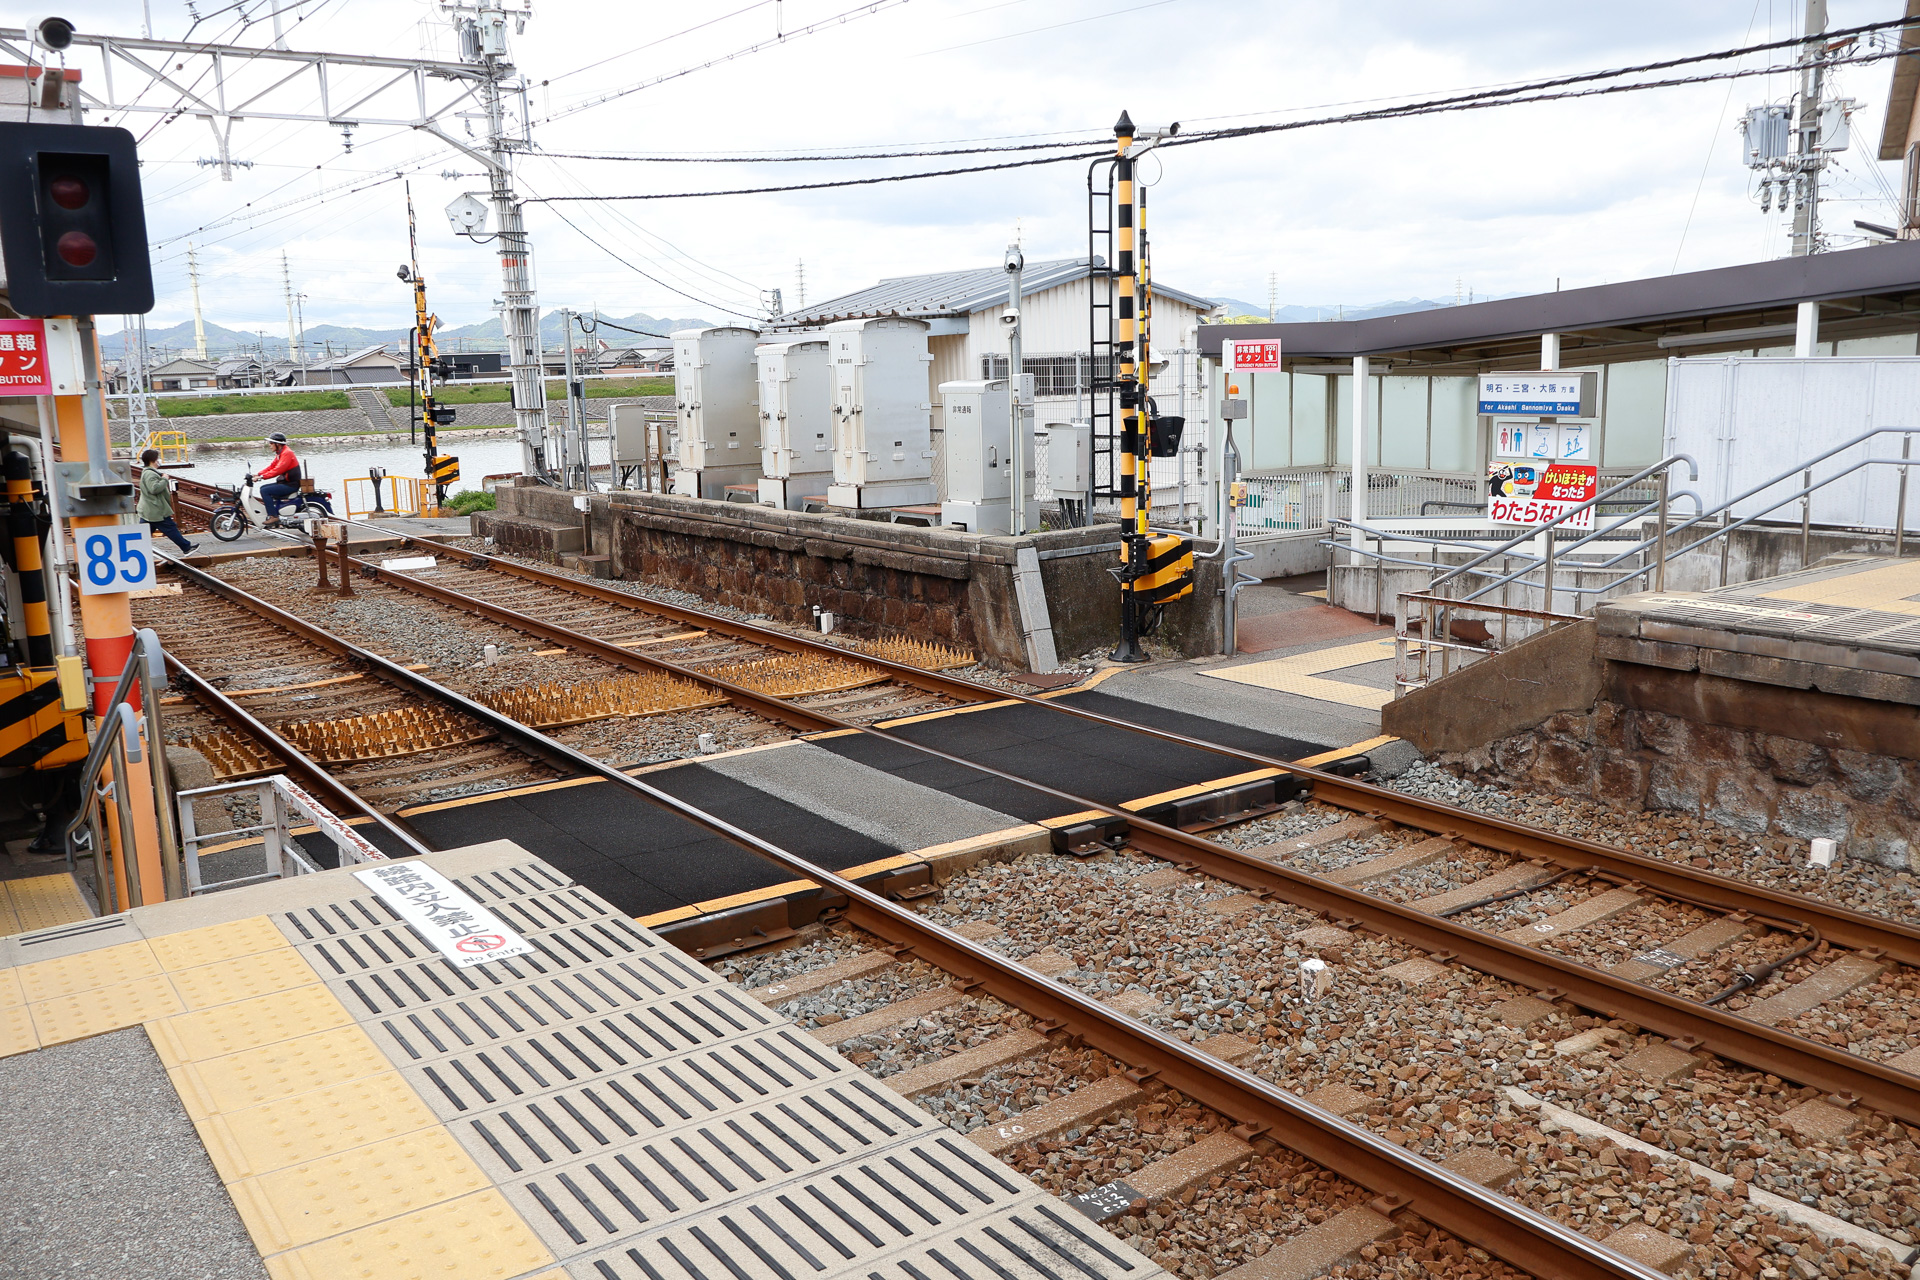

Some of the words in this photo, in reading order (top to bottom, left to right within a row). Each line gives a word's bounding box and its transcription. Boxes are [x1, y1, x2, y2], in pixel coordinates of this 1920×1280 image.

[0, 334, 37, 351] 通報
[1236, 345, 1261, 353] 非常通報
[0, 375, 42, 384] BUTTON
[1521, 404, 1553, 412] Sannomiya
[1545, 472, 1595, 487] けいほうきが
[1552, 485, 1585, 499] なったら
[85, 533, 148, 586] 85
[372, 865, 490, 939] 線路内立入禁止
[463, 954, 484, 964] No
[487, 946, 524, 958] Entry
